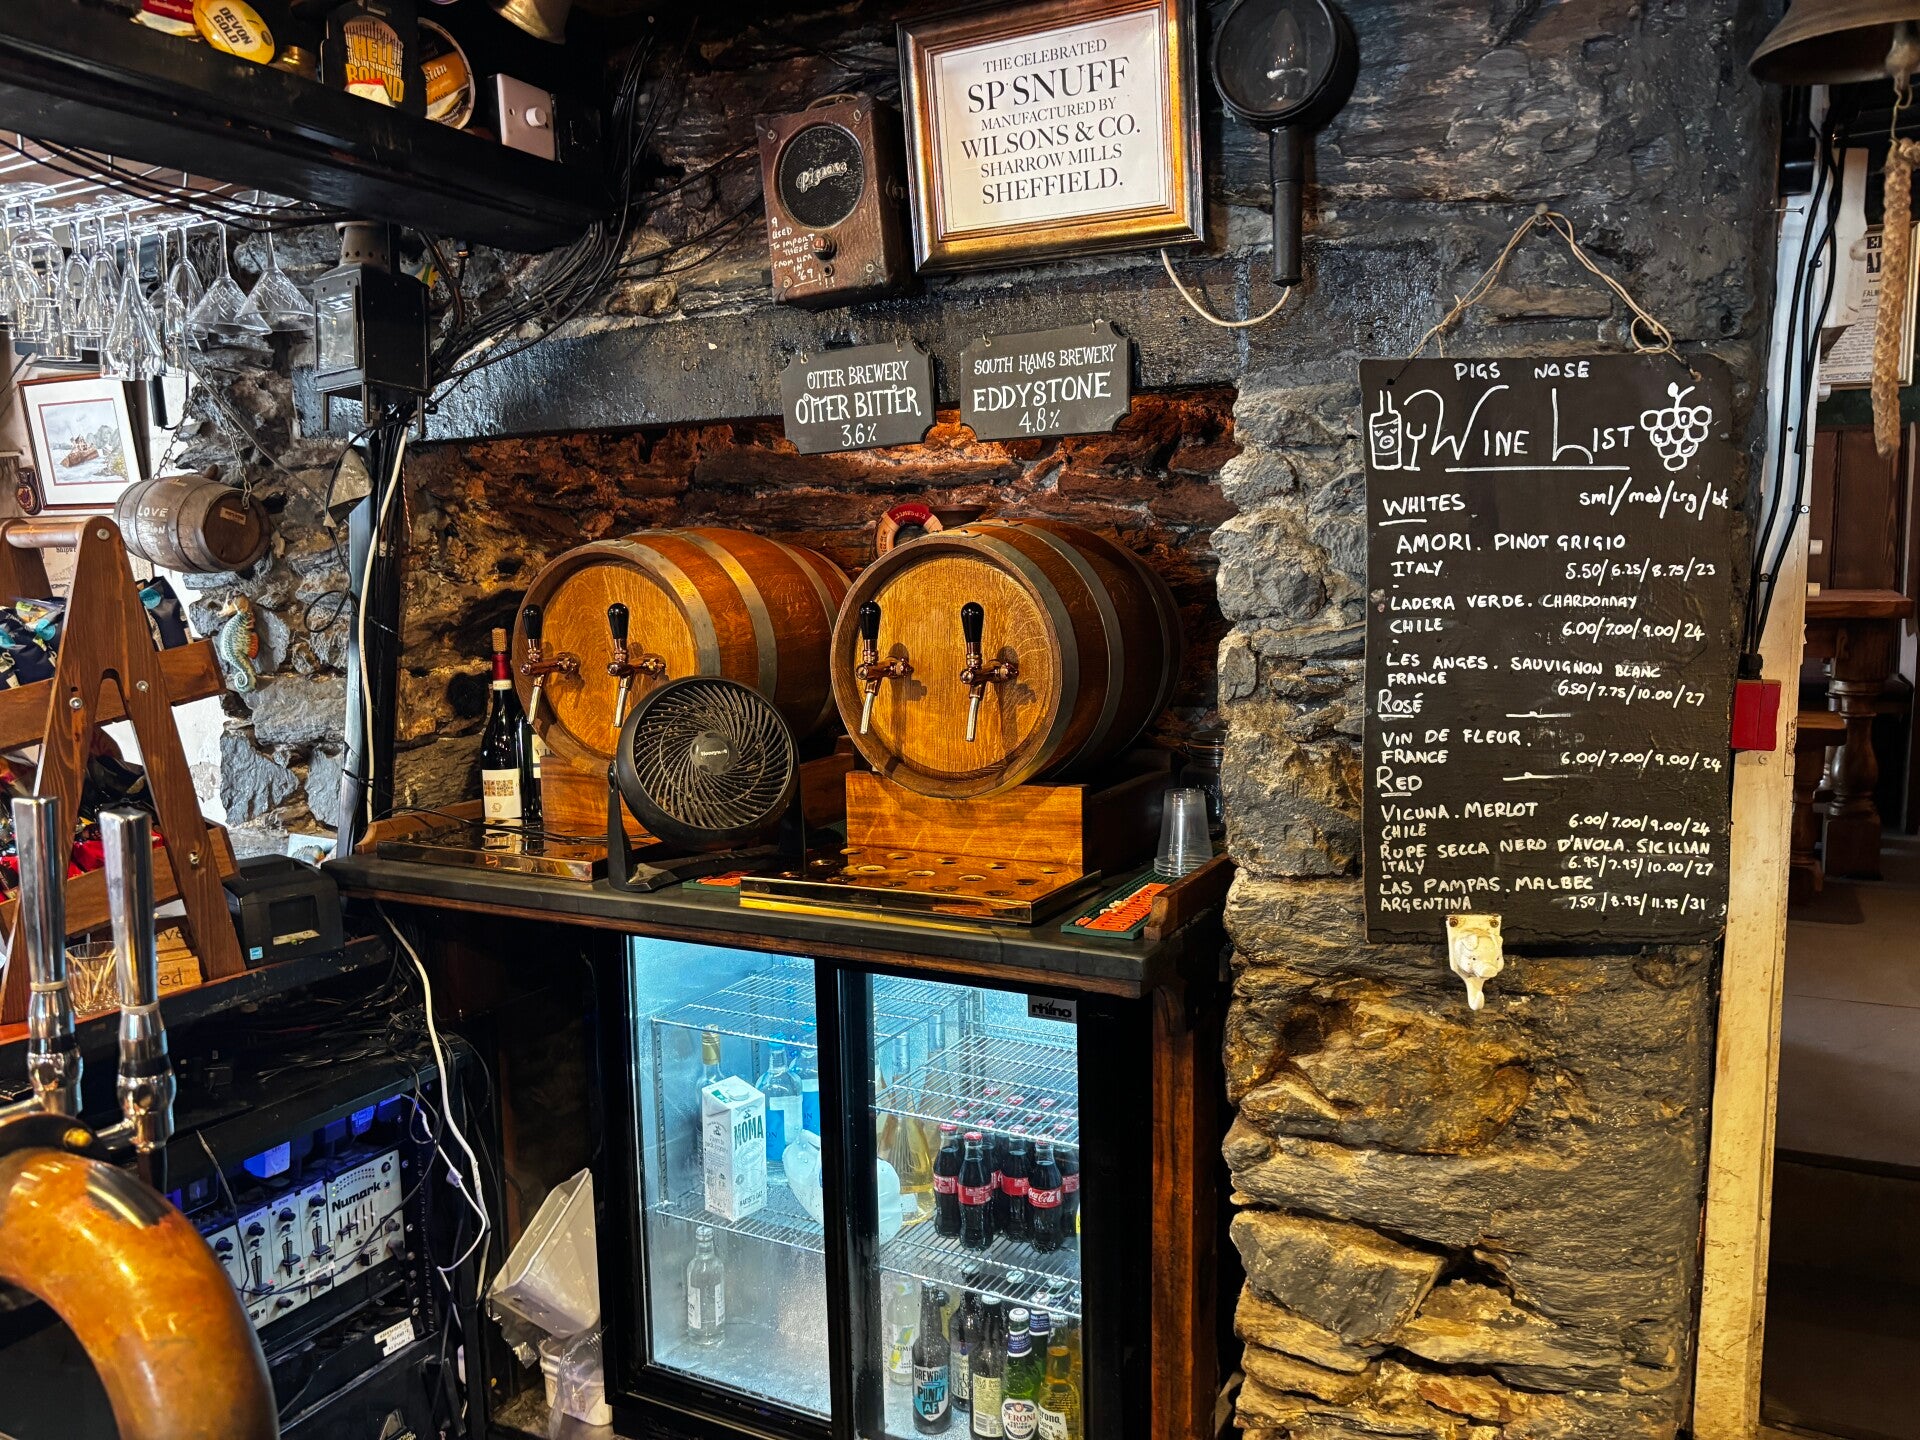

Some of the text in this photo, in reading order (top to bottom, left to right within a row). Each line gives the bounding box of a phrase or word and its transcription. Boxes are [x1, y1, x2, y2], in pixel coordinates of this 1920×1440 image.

[213, 15, 240, 44] GOLD
[219, 7, 253, 46] DEVON
[353, 34, 395, 69] HELL
[983, 38, 1107, 74] THE CELEBRATED
[968, 57, 1130, 114] SP SNUFF
[981, 97, 1117, 131] MANUFACTURED BY
[961, 113, 1141, 160] WILSONS & CO.
[981, 143, 1122, 178] SHARROW MILLS
[983, 167, 1124, 204] SHEFFIELD.
[772, 227, 793, 240] USED
[782, 233, 815, 248] IMPORT
[782, 242, 809, 257] THESE
[773, 258, 794, 270] FROM
[793, 263, 803, 273] IN
[973, 343, 1118, 375] SOUTH HAMS BREWERY
[807, 361, 909, 390] OTTER BREWERY
[1454, 361, 1590, 380] PIGS NOSE
[973, 370, 1112, 413] EDDYSTONE
[795, 384, 922, 425] OTTER BITTER
[1404, 385, 1530, 461] WINE
[138, 505, 168, 517] LOVE
[1383, 494, 1466, 516] WHITES
[1494, 534, 1550, 551] PINOT
[1557, 534, 1626, 551] GRIGIO
[1391, 560, 1443, 577] ITALY
[1391, 595, 1455, 611] LADERA
[1390, 618, 1443, 634] CHILE
[1387, 652, 1420, 668] LES
[1511, 657, 1603, 675] SAUVIGNON
[1615, 664, 1662, 678] BLANC
[1387, 672, 1447, 687] FRANCE
[1382, 731, 1413, 747] VIN
[1425, 729, 1450, 743] DE
[1381, 748, 1449, 764] FRANCE
[1376, 765, 1423, 792] RED
[1465, 802, 1538, 818] MERLOT
[1382, 823, 1427, 840] CHILE
[1380, 843, 1427, 860] RUPE
[1500, 838, 1547, 852] NERO
[1382, 859, 1425, 875] ITALY
[1380, 880, 1413, 895] LAS
[1515, 876, 1593, 891] MALBEC
[1380, 896, 1471, 913] ARGENTINA
[733, 1114, 764, 1152] MOMA
[332, 1182, 381, 1213] Numark
[917, 1386, 945, 1402] PUNK
[923, 1402, 938, 1413] AF
